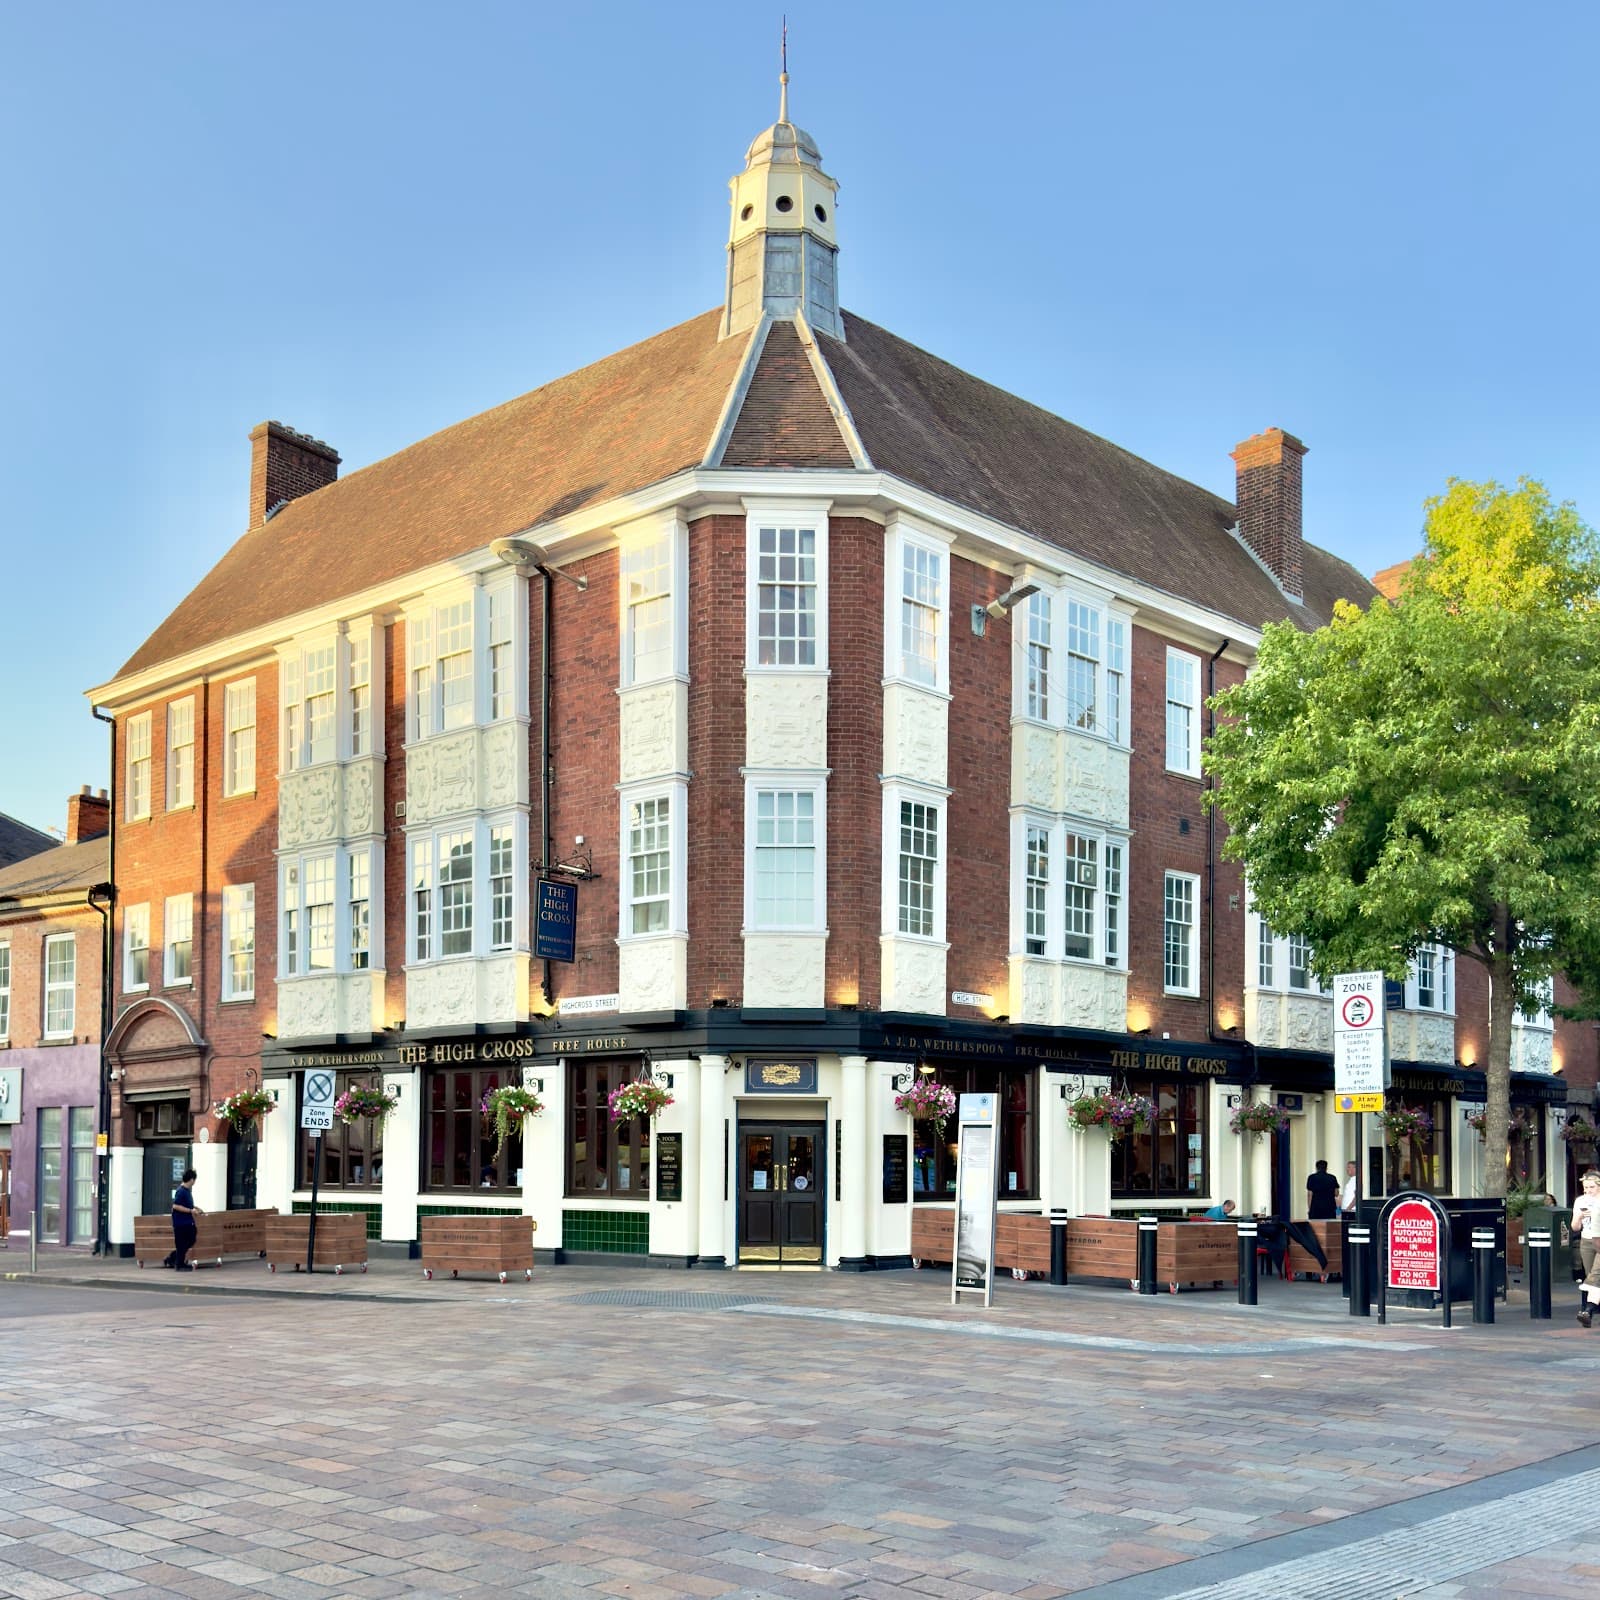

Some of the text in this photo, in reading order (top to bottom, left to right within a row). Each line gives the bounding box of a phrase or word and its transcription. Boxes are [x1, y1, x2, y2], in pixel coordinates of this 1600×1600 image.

[547, 886, 567, 899] THE
[544, 898, 569, 911] HIGH
[541, 911, 571, 925] CROSS
[1336, 974, 1379, 983] PEDESTRIAN
[1342, 982, 1373, 993] ZONE
[594, 998, 617, 1008] STREET
[956, 994, 970, 1002] HIGH
[397, 1037, 628, 1064] THE HIGH CROSS FREE HOUSE
[883, 1035, 890, 1046] A
[924, 1039, 1004, 1055] WETHERSPOON
[1015, 1046, 1040, 1057] FREE
[319, 1052, 385, 1065] WETHERSPOON
[1110, 1050, 1227, 1075] THE HIGH CROSS
[1408, 1075, 1435, 1091] HIGH
[1437, 1077, 1465, 1093] CROSS
[304, 1117, 330, 1126] ENDS
[1394, 1219, 1432, 1227] CAUTION
[1412, 1271, 1428, 1279] NOT
[1397, 1278, 1431, 1286] TAILGATE
